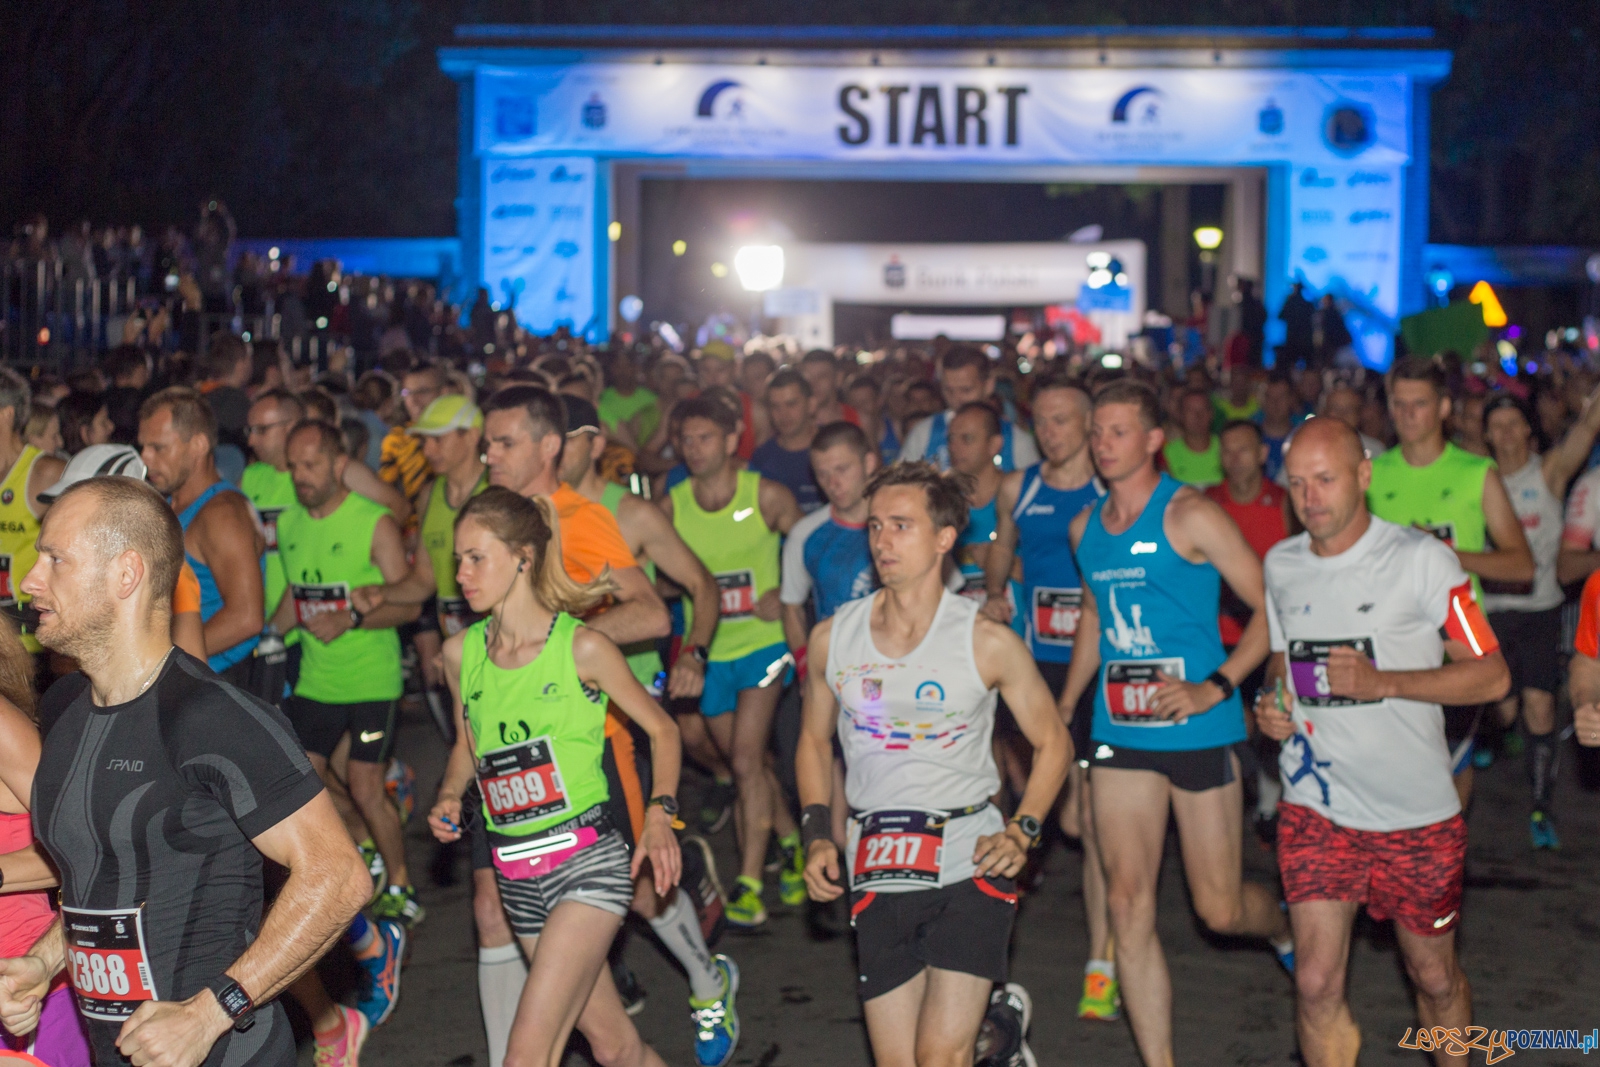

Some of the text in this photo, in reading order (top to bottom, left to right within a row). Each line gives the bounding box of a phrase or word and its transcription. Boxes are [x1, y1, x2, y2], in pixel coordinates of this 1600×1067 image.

[837, 84, 1028, 146] START
[487, 771, 546, 812] 8589
[579, 804, 602, 827] PRO
[864, 835, 922, 868] 2217
[68, 948, 131, 996] 2388
